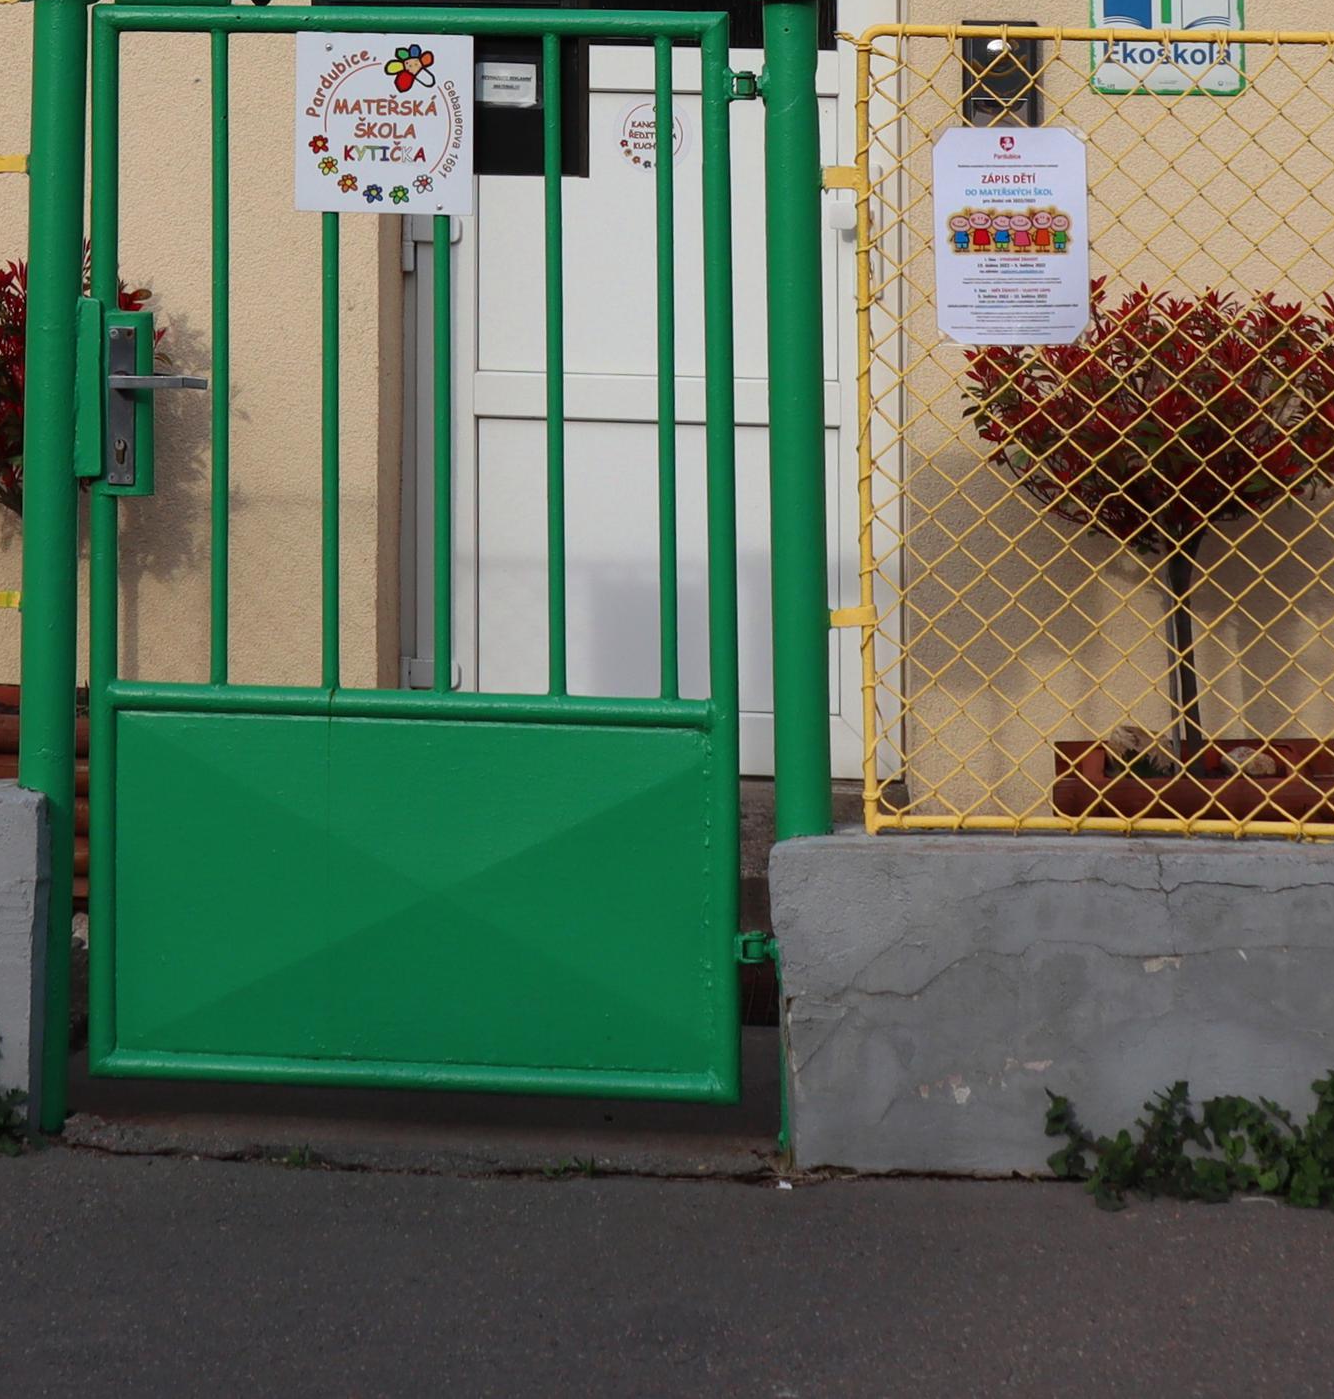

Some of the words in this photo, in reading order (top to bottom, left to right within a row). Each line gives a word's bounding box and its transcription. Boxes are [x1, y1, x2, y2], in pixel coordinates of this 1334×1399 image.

[305, 50, 377, 118] Pardubice,
[333, 94, 438, 117] MATEŘSKÁ
[443, 80, 464, 150] Gebauerova
[354, 117, 416, 140] ŠKOLA
[344, 141, 427, 163] KYTIČKA
[439, 152, 460, 179] 1691
[981, 172, 1010, 184] ZÁPIS
[1012, 172, 1036, 184] DĚTÍ
[965, 188, 978, 196] DO
[979, 186, 1032, 196] MATEŘSKÝCH
[1033, 186, 1054, 196] ŠKOL
